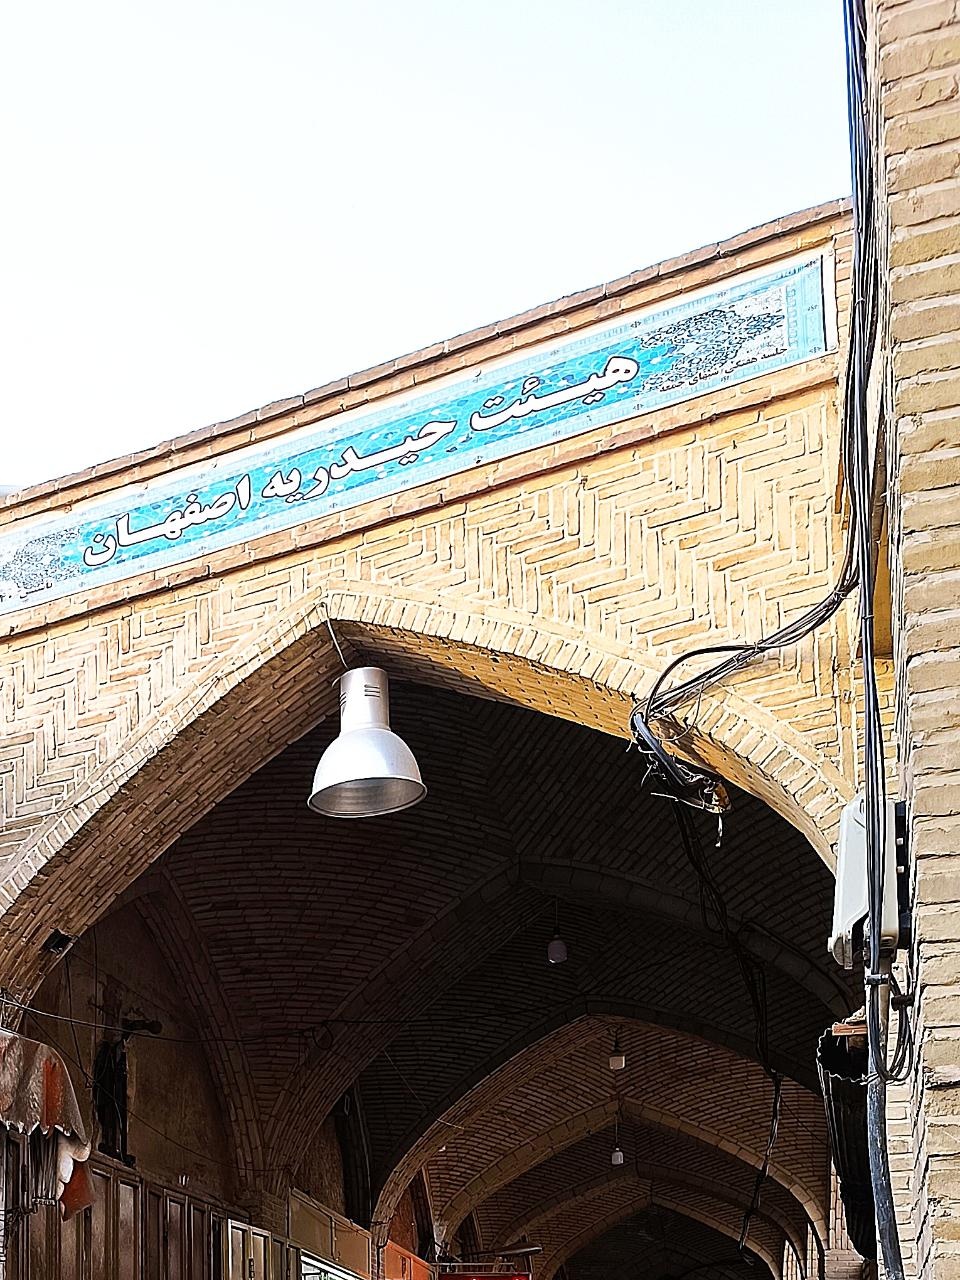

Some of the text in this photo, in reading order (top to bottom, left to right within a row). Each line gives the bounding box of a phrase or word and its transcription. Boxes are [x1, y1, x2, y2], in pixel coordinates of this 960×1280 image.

[83, 355, 641, 567] هیئت حیدریه اصفهان
